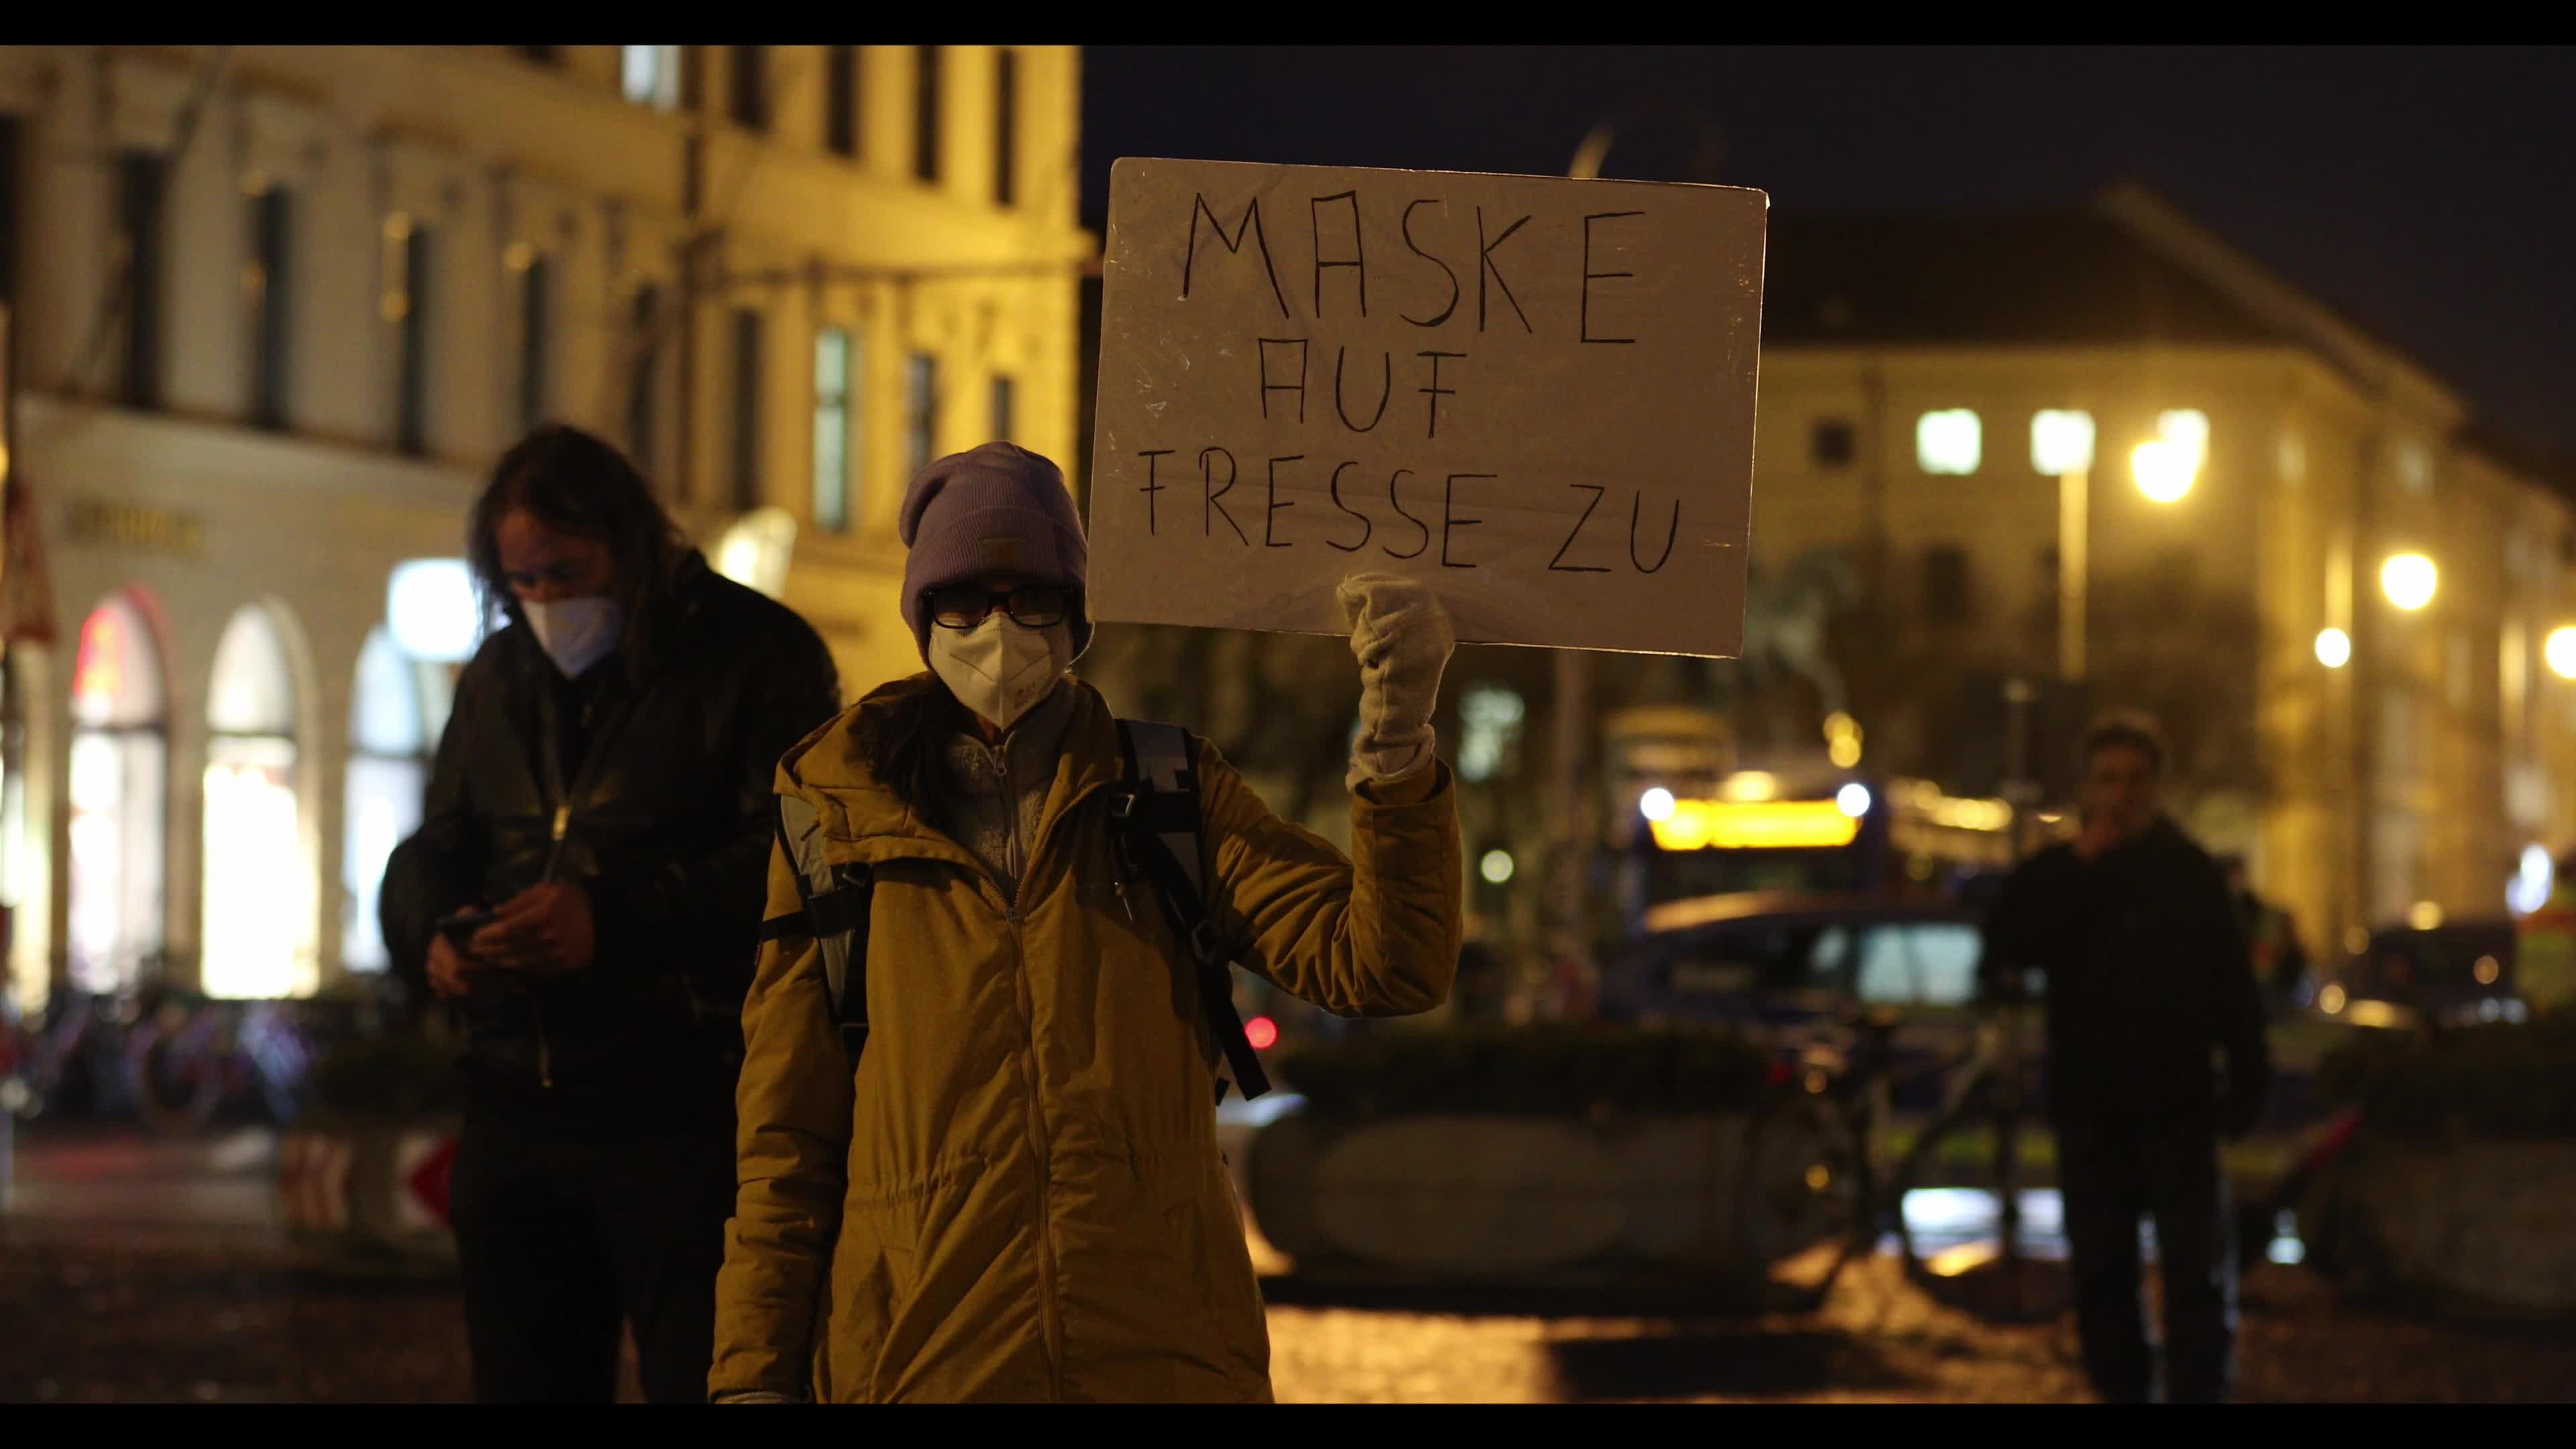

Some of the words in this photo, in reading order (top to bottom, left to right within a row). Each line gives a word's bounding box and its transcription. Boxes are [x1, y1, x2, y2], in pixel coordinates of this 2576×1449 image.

[1184, 191, 1646, 343] MASKE
[1258, 337, 1467, 439] AUF
[1138, 446, 1498, 569] FRESSE
[1548, 484, 1680, 574] ZU
